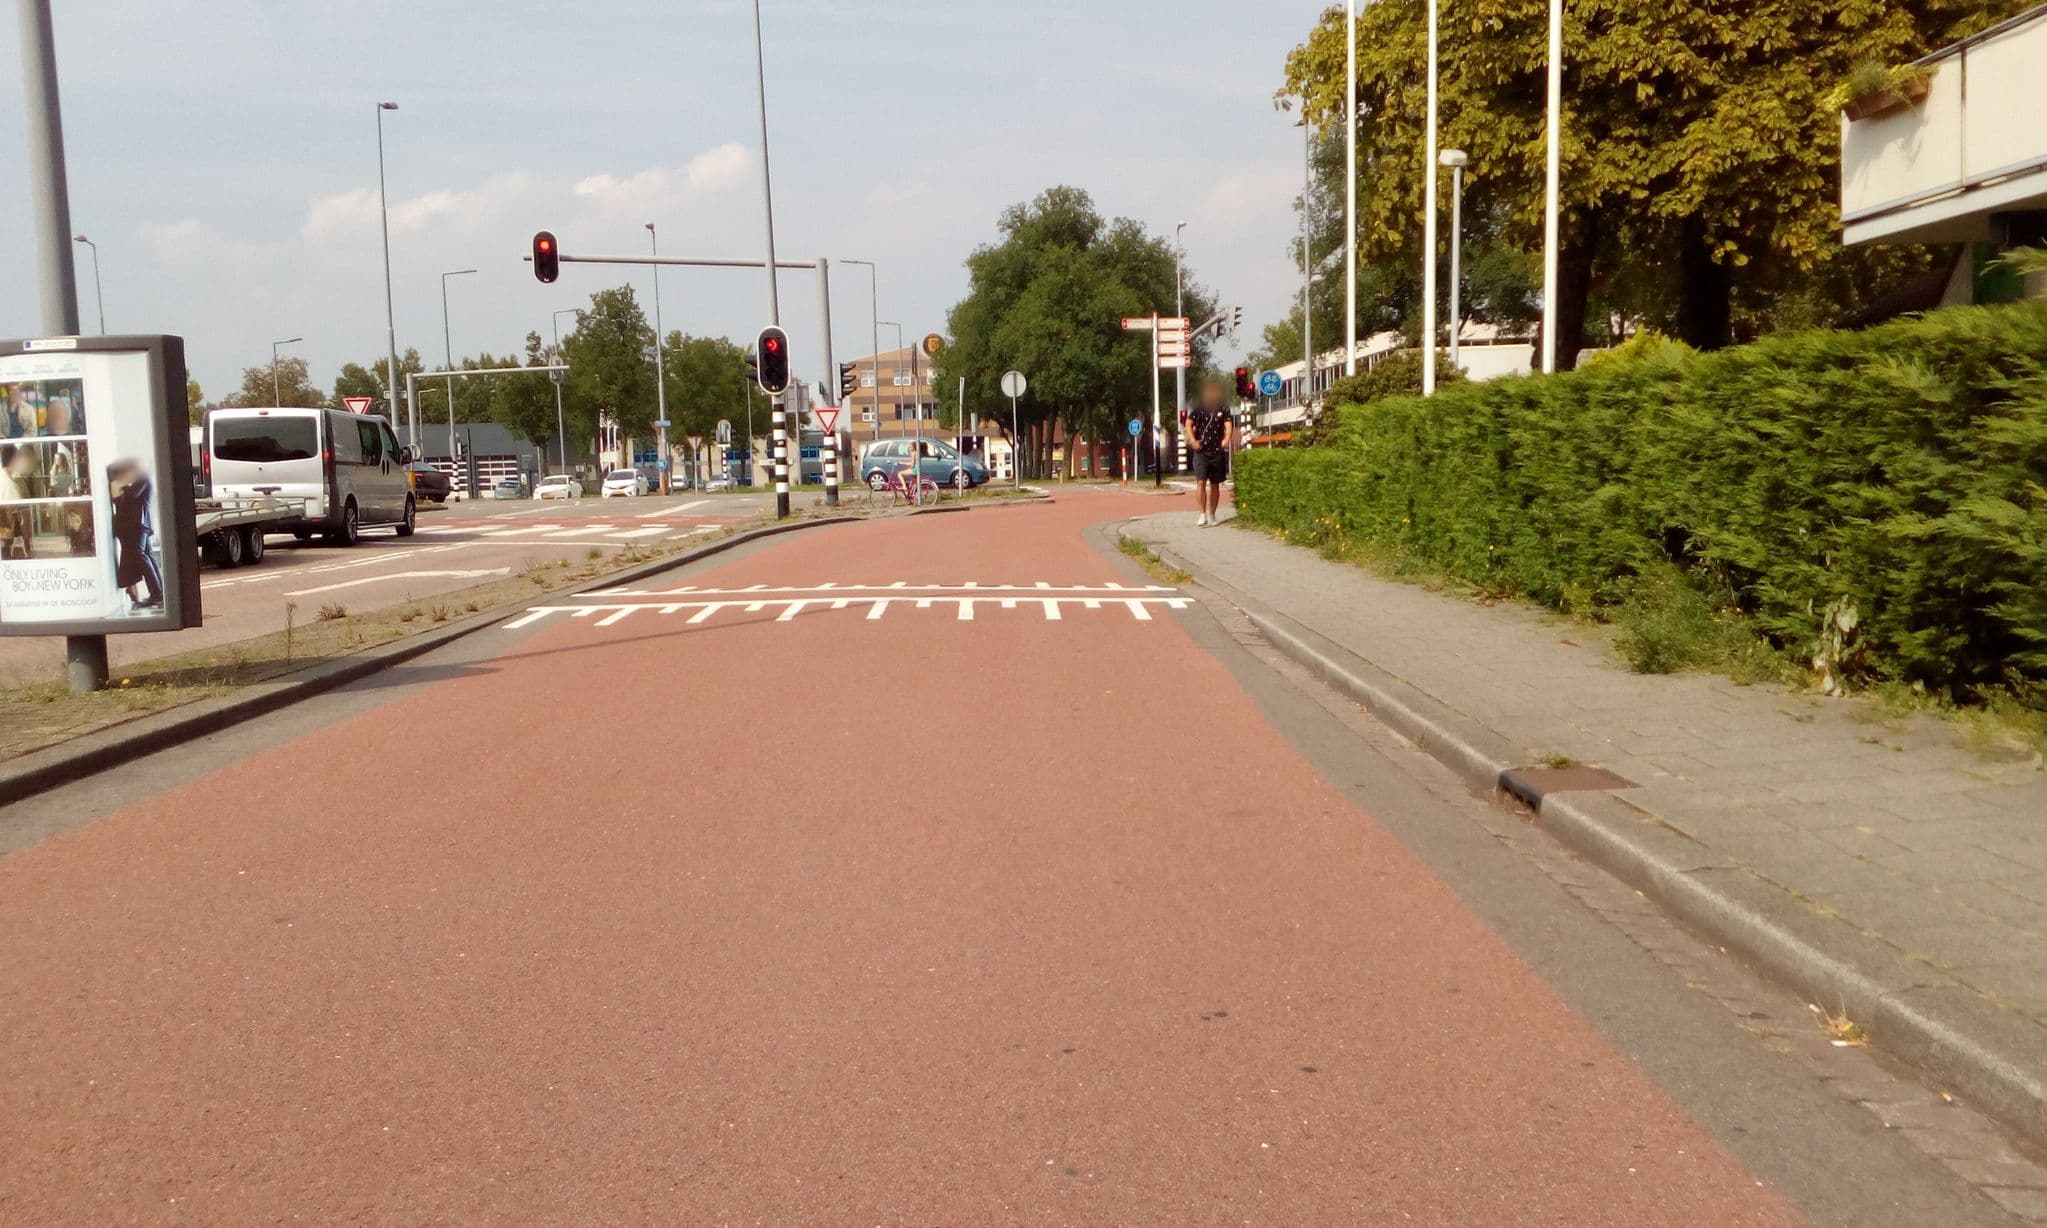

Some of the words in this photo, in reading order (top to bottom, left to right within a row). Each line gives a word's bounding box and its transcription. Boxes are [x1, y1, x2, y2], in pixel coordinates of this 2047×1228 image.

[3, 568, 29, 581] ONLY
[30, 567, 69, 580] LIVING
[12, 580, 32, 592] BOY
[36, 579, 61, 592] NEW
[62, 577, 97, 591] YORK
